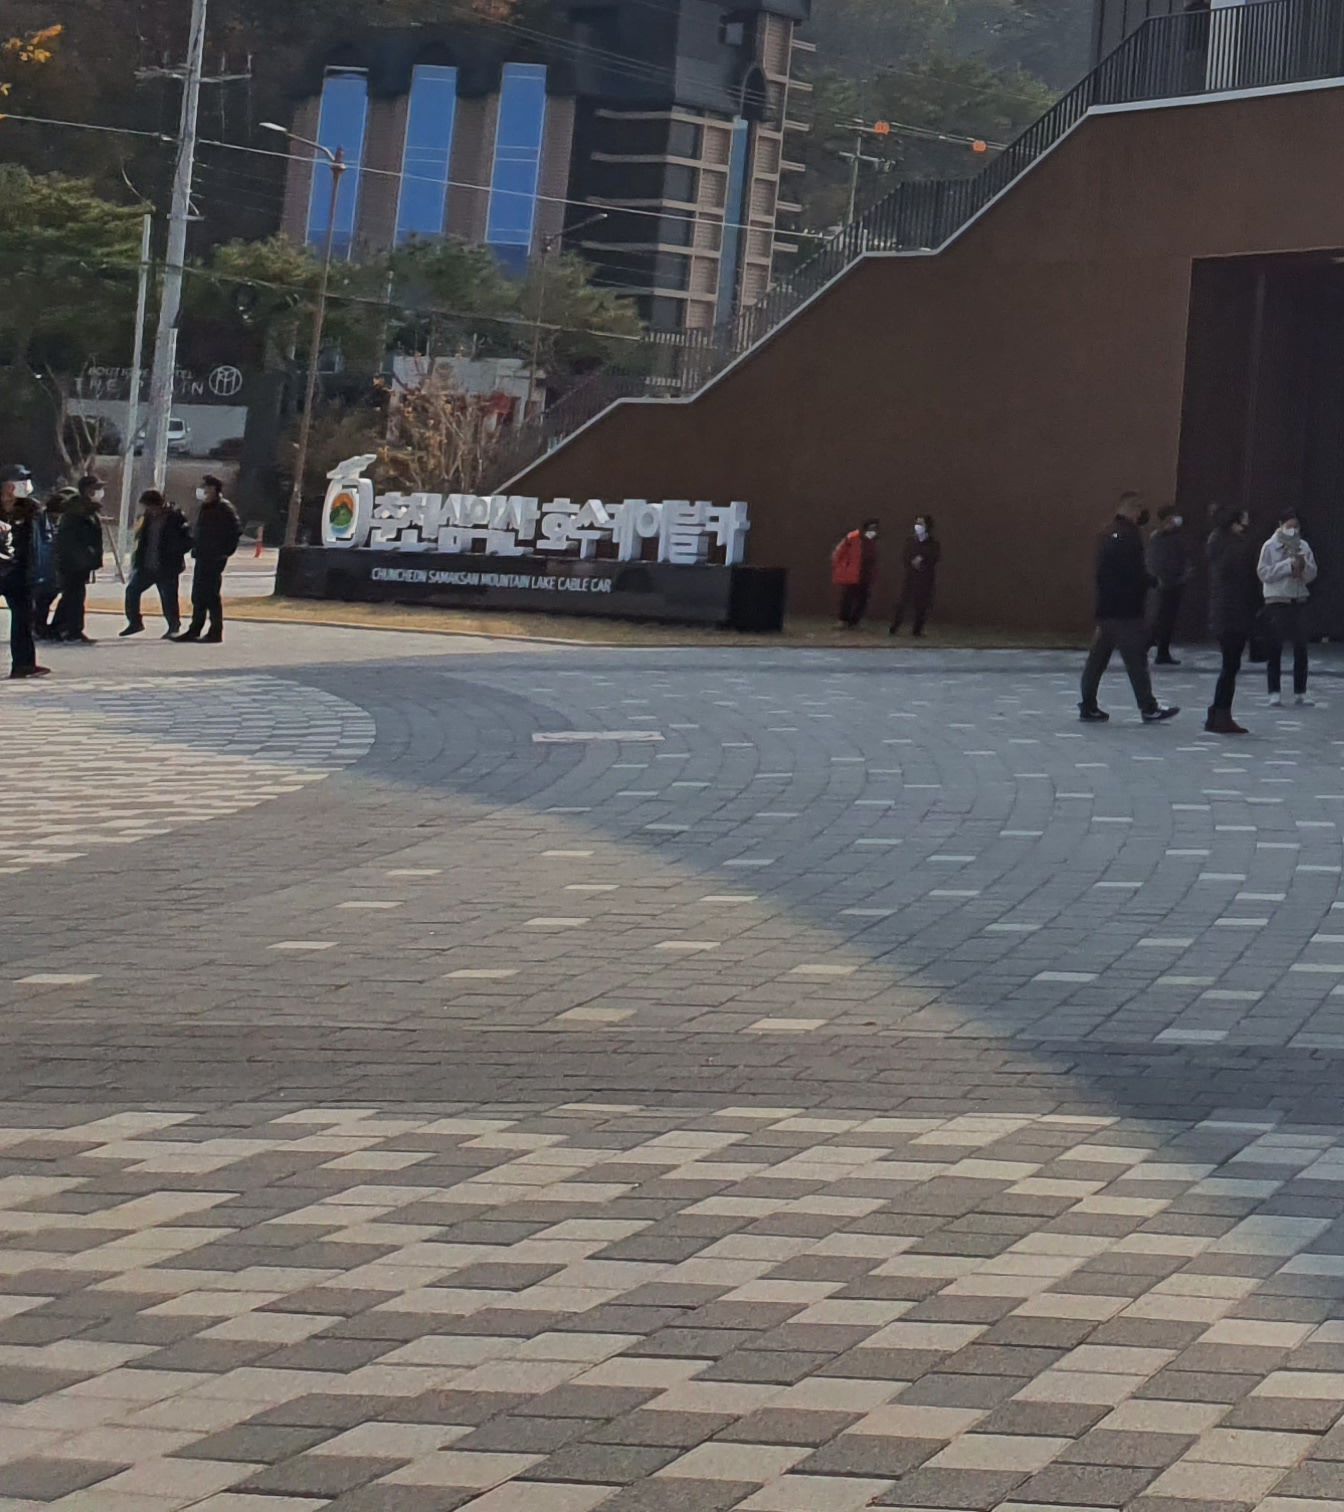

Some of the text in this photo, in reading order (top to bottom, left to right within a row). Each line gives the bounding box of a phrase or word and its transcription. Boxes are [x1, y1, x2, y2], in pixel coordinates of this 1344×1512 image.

[370, 492, 750, 565] 춘천 삼악산 호수케이블카
[531, 575, 557, 589] LAKE
[557, 577, 588, 592] CABLE
[590, 578, 612, 593] CAR
